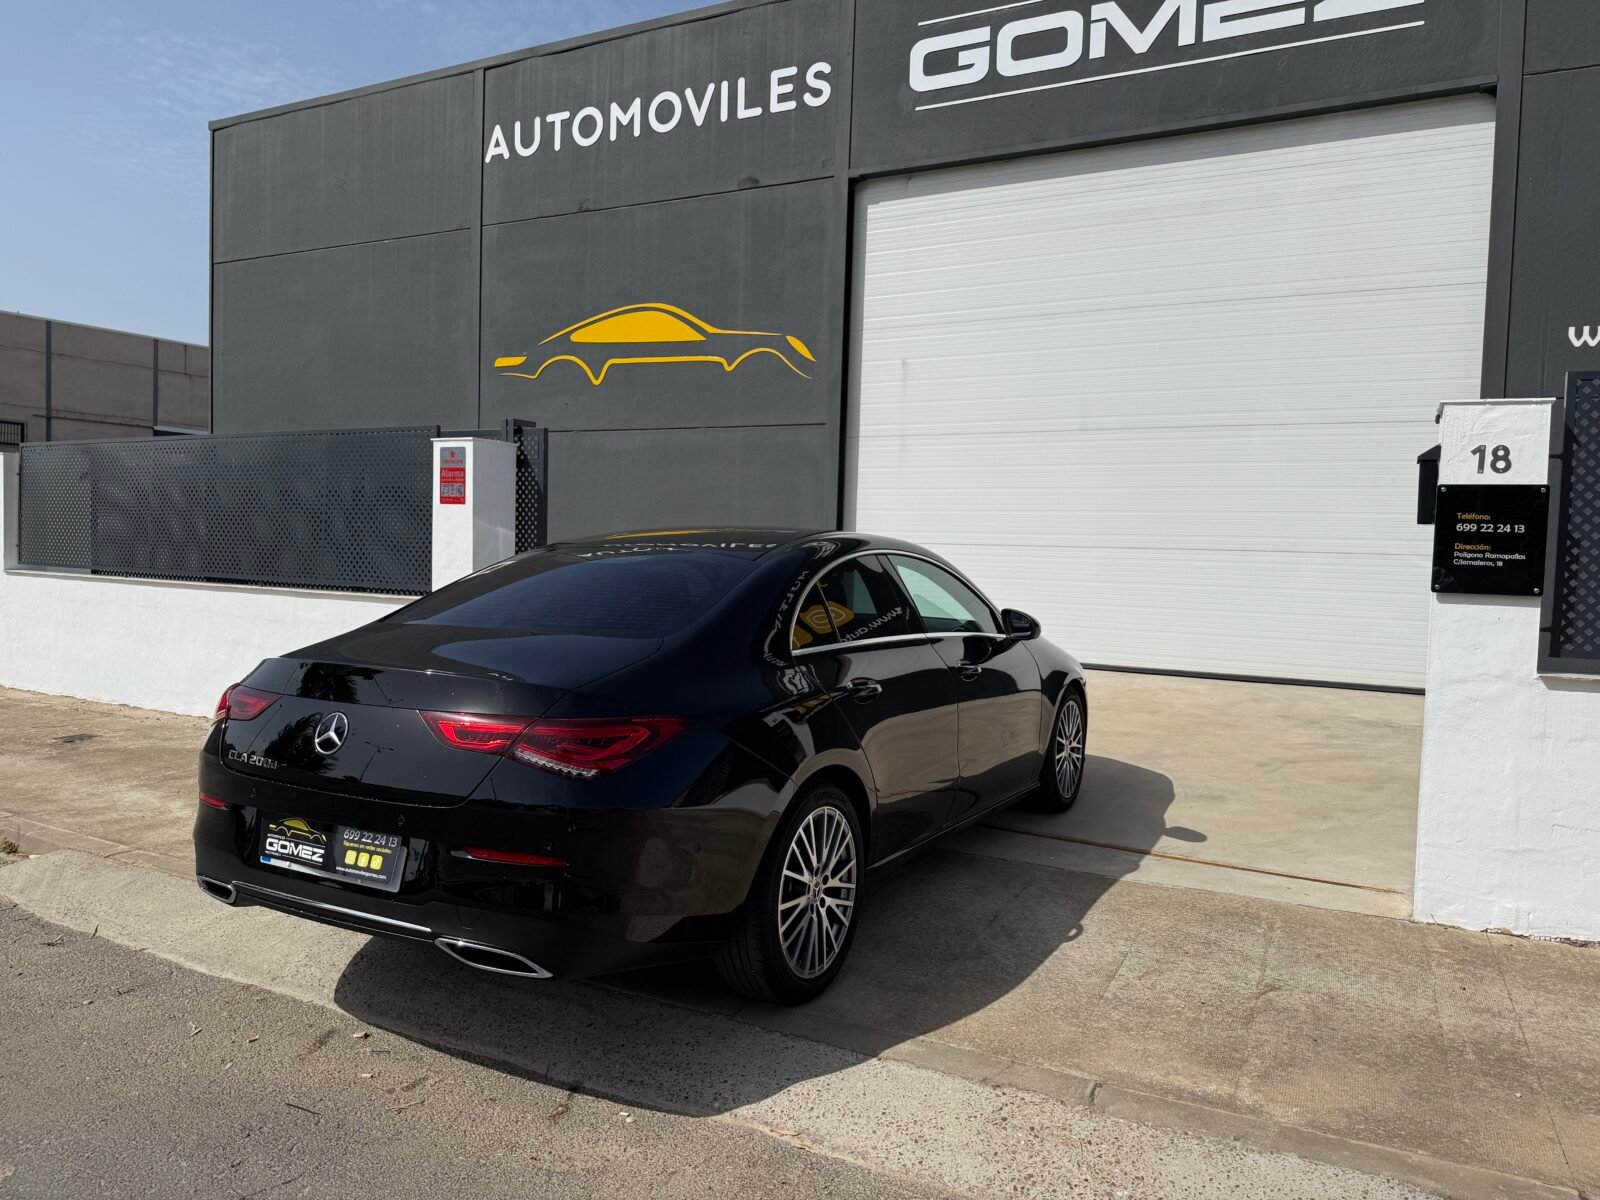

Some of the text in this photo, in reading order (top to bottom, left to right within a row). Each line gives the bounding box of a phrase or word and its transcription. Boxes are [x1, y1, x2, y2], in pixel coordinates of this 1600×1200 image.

[485, 61, 832, 164] AUTOMOVILES
[1470, 444, 1512, 474] 18
[1456, 523, 1526, 533] 699 22 24 13
[228, 749, 248, 763] CLA
[343, 829, 398, 848] 699 22 24 13
[265, 837, 325, 863] GOMEZ
